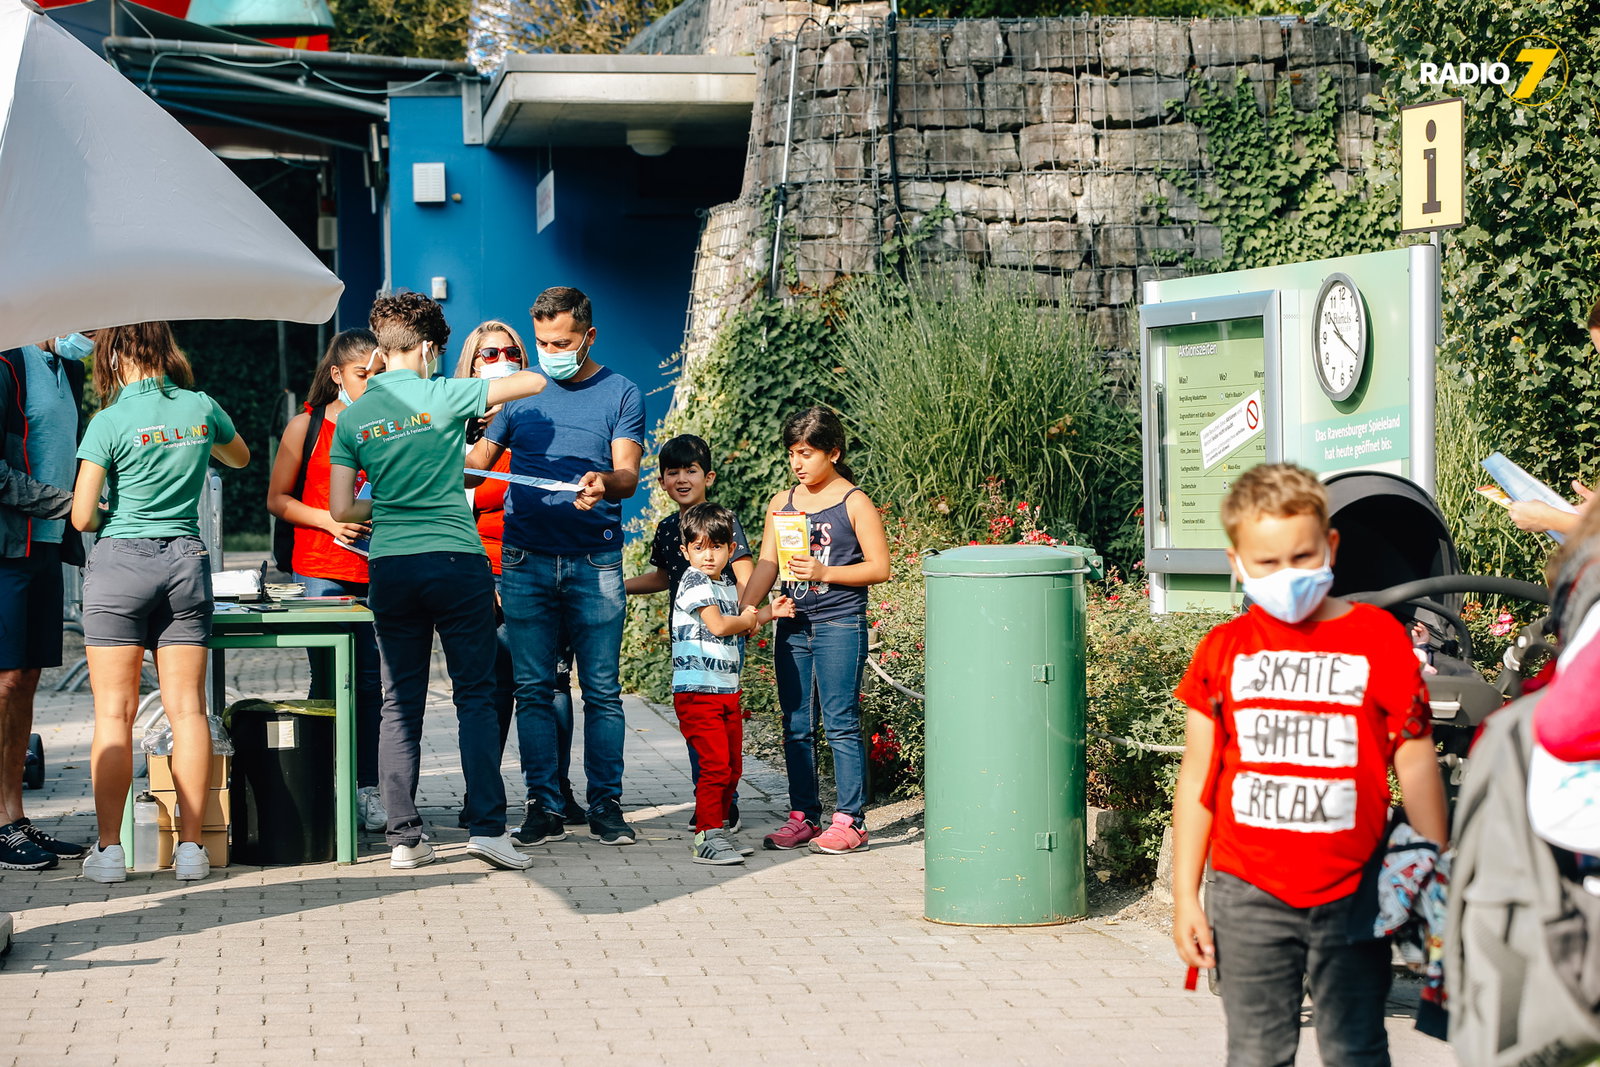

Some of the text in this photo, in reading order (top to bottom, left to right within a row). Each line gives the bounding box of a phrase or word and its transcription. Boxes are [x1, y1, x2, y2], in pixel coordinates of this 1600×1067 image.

[1422, 119, 1441, 214] i
[1339, 286, 1346, 300] 12
[1330, 295, 1337, 309] 11
[1325, 311, 1331, 325] 10
[1322, 331, 1328, 344] 9
[1178, 342, 1218, 358] Aktionszeiten
[1325, 352, 1330, 365] 8
[1219, 372, 1228, 381] Wo?
[1331, 367, 1336, 380] 7
[1340, 373, 1345, 386] 6
[356, 412, 431, 444] SPIELELAND
[1314, 413, 1400, 442] Das Ravensburger Spieleland
[133, 424, 209, 448] SPIELELAND
[1324, 437, 1392, 460] hat heute geöffnet bis:
[1255, 655, 1345, 695] SKATE
[1250, 778, 1329, 823] RELAX
